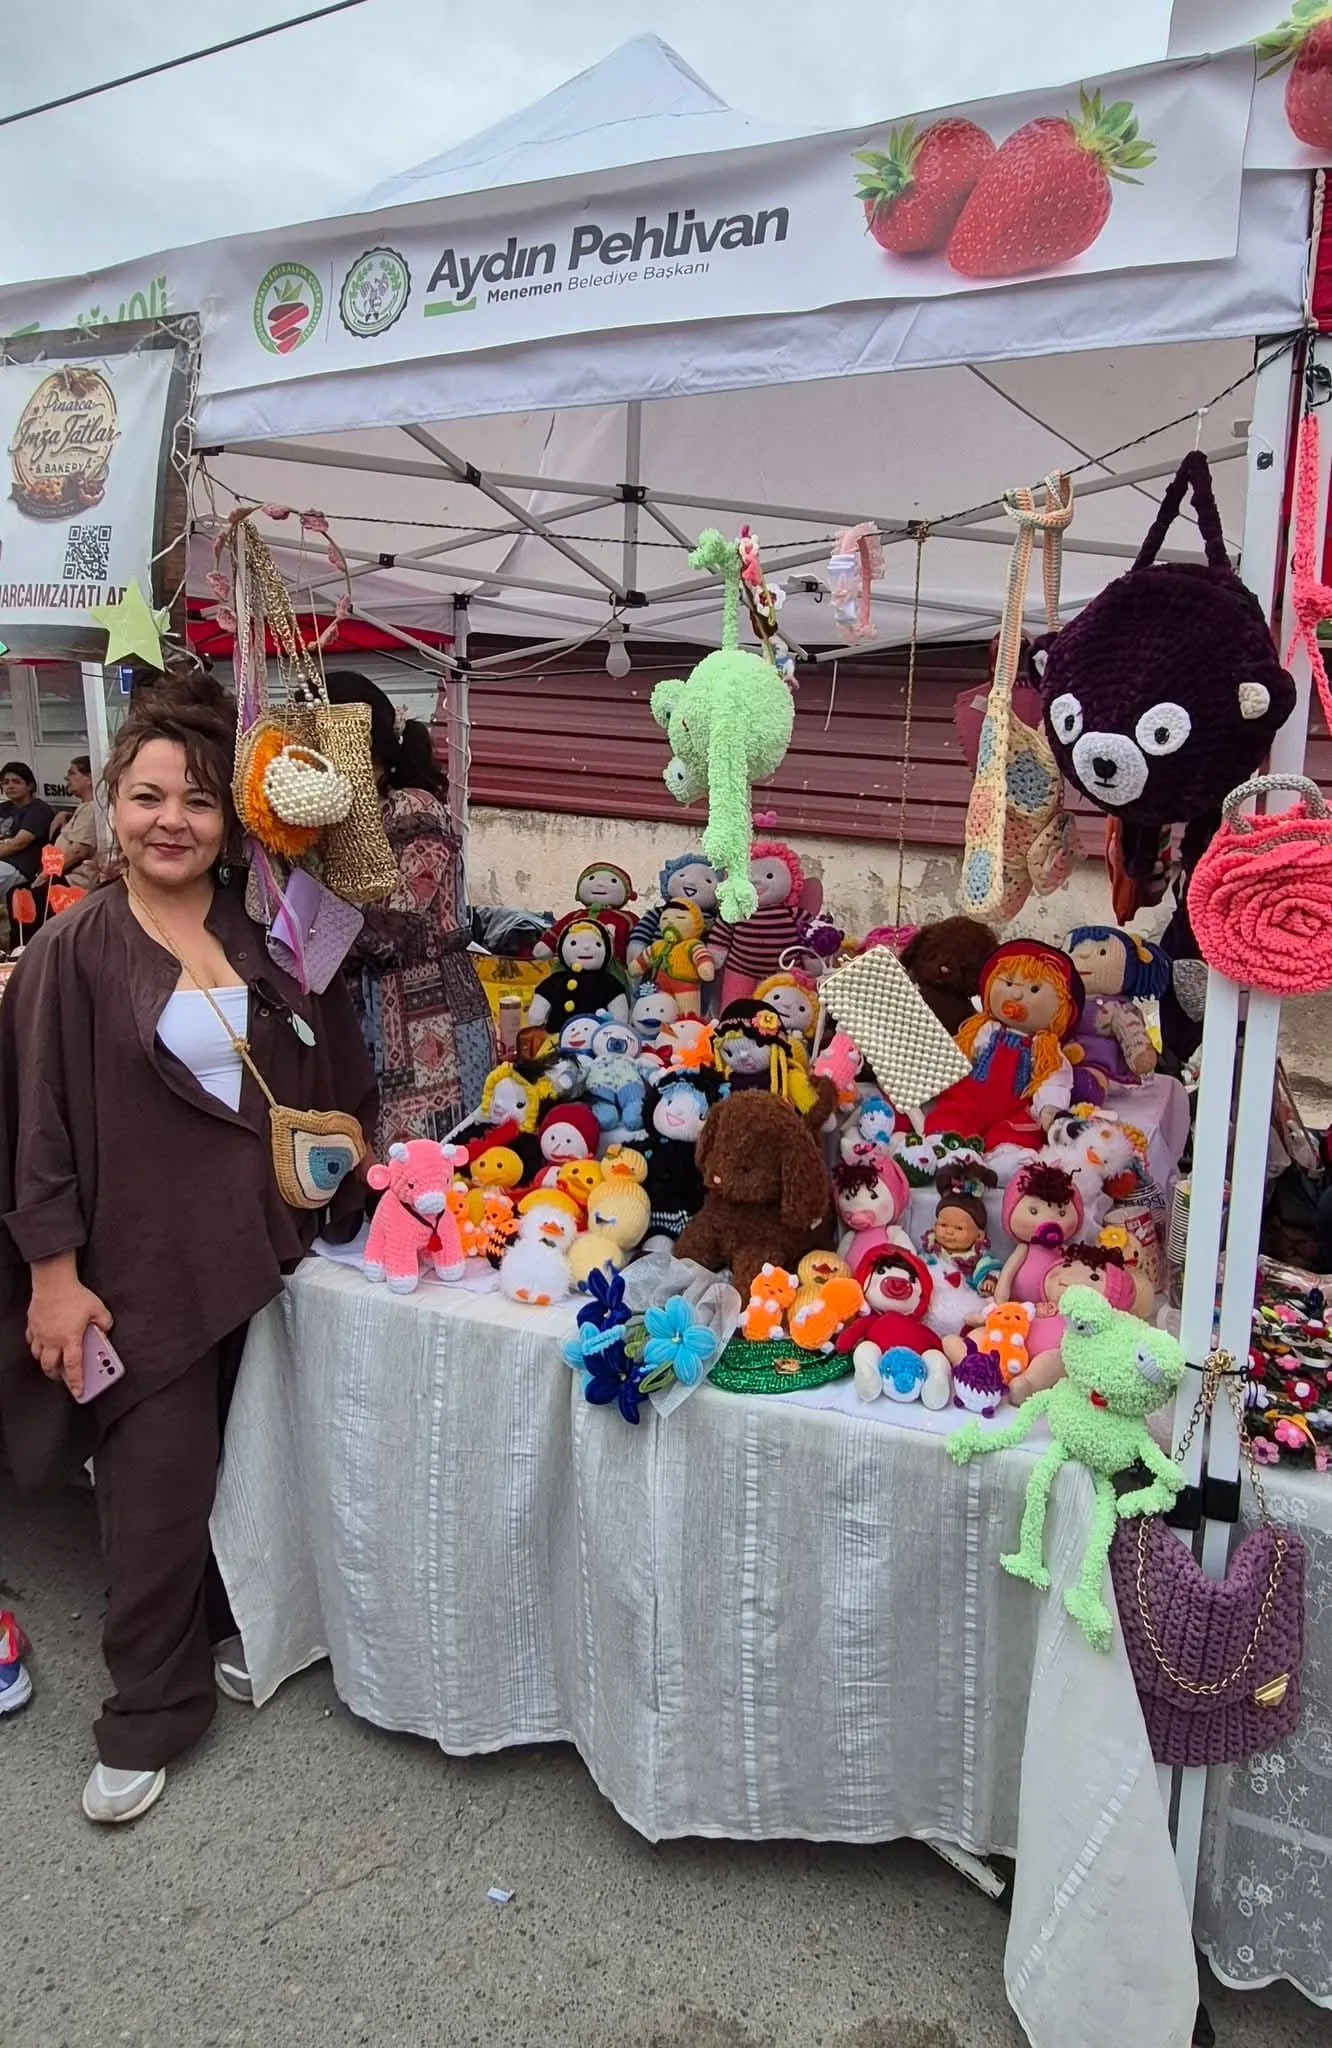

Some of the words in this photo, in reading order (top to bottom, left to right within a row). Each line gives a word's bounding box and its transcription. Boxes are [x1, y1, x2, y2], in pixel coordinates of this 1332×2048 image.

[426, 237, 556, 301] Aydın
[568, 207, 789, 270] Pehlivan
[487, 281, 563, 304] Menemen
[568, 269, 638, 291] Belediye
[643, 262, 711, 279] Başkanı
